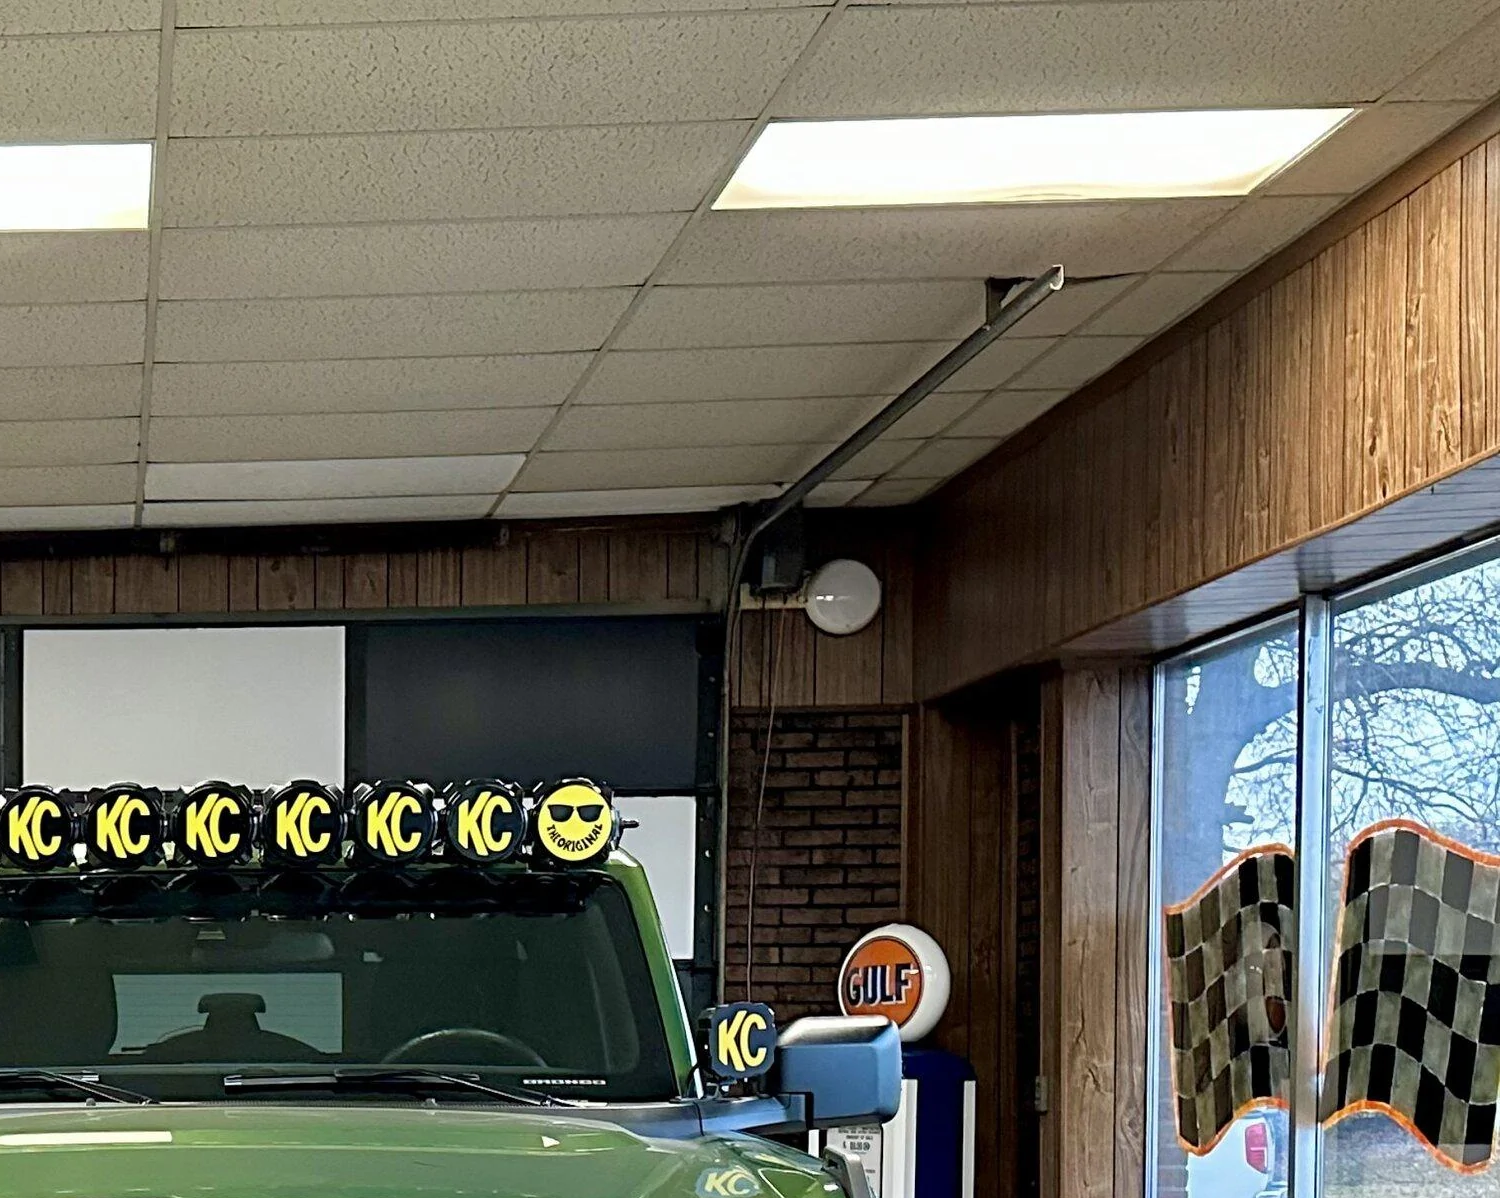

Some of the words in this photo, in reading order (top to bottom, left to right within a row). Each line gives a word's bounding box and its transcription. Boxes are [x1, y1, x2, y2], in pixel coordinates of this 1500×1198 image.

[8, 796, 62, 860] KC
[96, 795, 150, 859] KC
[186, 793, 240, 858] KC
[276, 792, 331, 857] KC
[367, 791, 422, 857] KC
[458, 791, 512, 856] KC
[547, 824, 561, 843] THE
[557, 824, 603, 852] ORIGINAL
[846, 963, 918, 1007] GULF
[718, 1010, 767, 1071] KC
